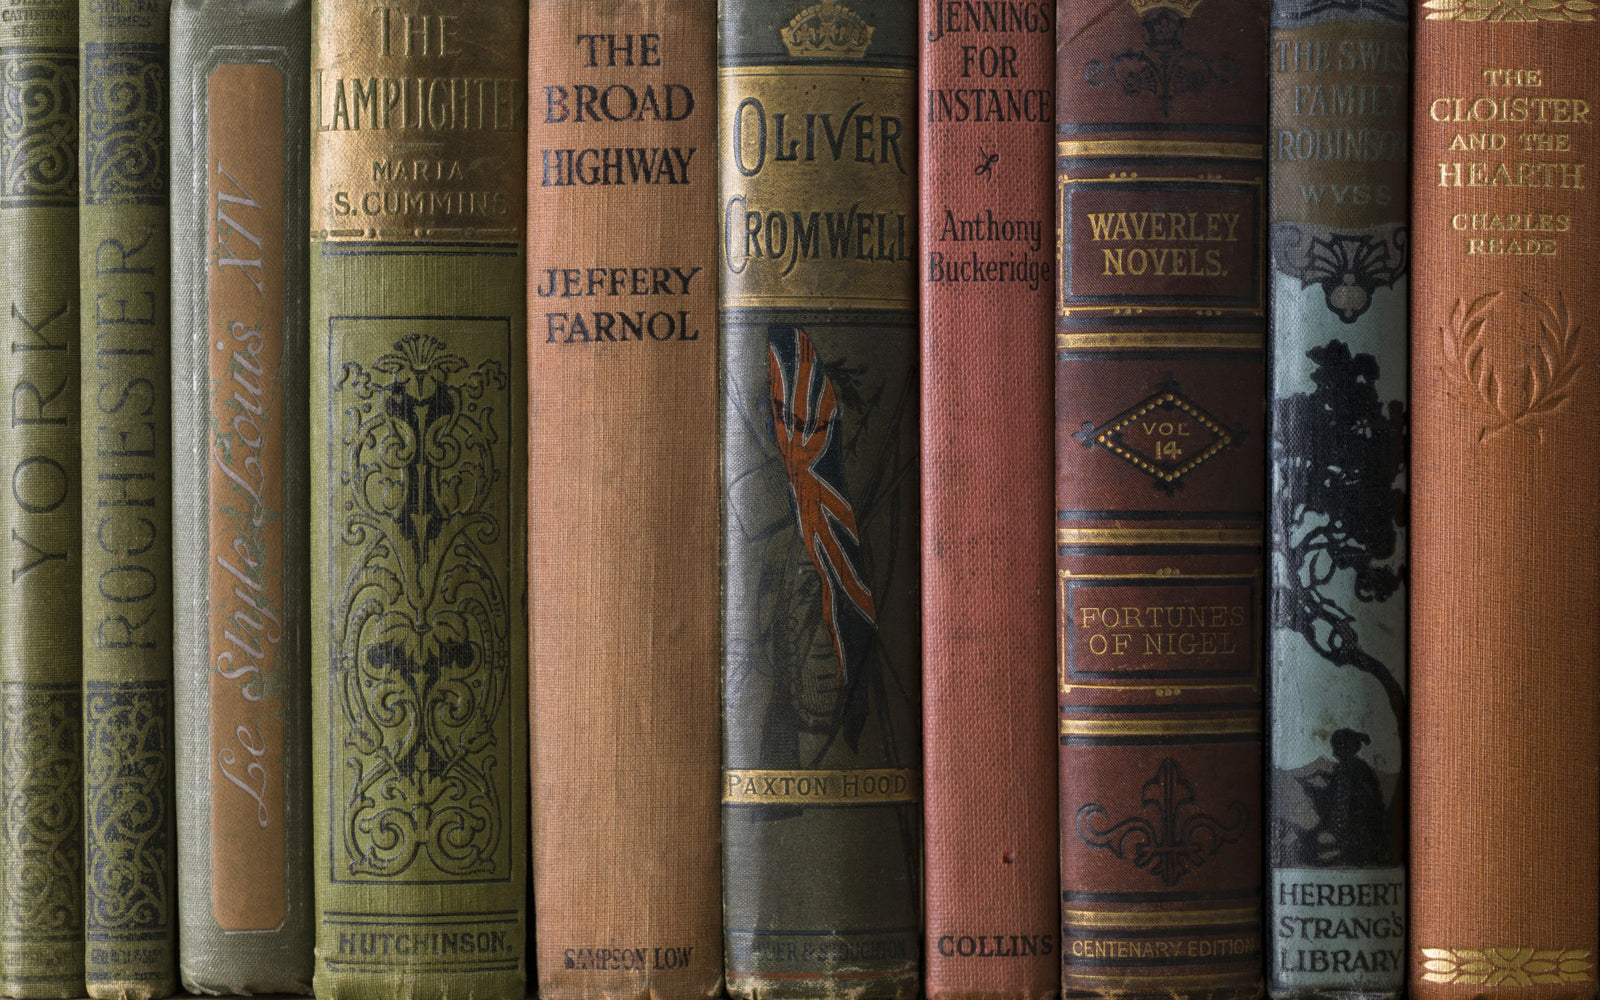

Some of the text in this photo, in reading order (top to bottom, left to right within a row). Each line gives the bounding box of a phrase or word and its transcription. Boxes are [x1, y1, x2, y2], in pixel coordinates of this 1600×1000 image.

[371, 6, 463, 58] THE
[927, 0, 1051, 42] JENNINGS
[577, 33, 661, 67] THE
[960, 45, 1019, 79] FOR
[1275, 39, 1408, 72] THE SWIS
[1483, 69, 1542, 87] THE
[543, 83, 695, 124] BROAD
[927, 88, 1051, 124] INSTANCE
[1292, 84, 1403, 118] FAMILY
[1430, 97, 1591, 123] CLOISTER
[732, 96, 907, 177] OLIVER
[1448, 133, 1571, 151] AND THE
[371, 159, 464, 182] MARIA
[541, 147, 697, 187] HIGHWAY
[1437, 162, 1585, 189] HEARTH
[1299, 183, 1393, 205] WYSS
[725, 193, 912, 278] CROMWELL
[939, 209, 1042, 251] Anthony
[1086, 212, 1241, 241] WAVERLEY
[1451, 213, 1569, 232] CHARLES
[1467, 238, 1557, 256] READE
[927, 250, 1051, 291] Buckeridge
[1101, 249, 1228, 276] NOVELS.
[538, 266, 702, 298] JEFFERY
[545, 310, 699, 344] FARNOL
[12, 302, 68, 583] YORK
[97, 226, 156, 650] ROCHESTER
[1142, 422, 1190, 436] VOL
[1154, 440, 1183, 460] 14
[214, 159, 282, 828] Le Style Louis XIV
[1079, 606, 1245, 628] FORTUNES
[1089, 632, 1237, 655] OF NIGEL
[728, 773, 907, 797] PAXTON HOOD
[1278, 882, 1403, 907] HERBERT
[1278, 911, 1404, 939] STRANG'S
[338, 931, 513, 956] HUTCHINSON.
[937, 934, 1053, 957] COLLINS
[1071, 937, 1255, 959] CENTENARY EDITION
[563, 946, 695, 970] SAMPSON LOW
[1280, 947, 1402, 973] LIBRARY
